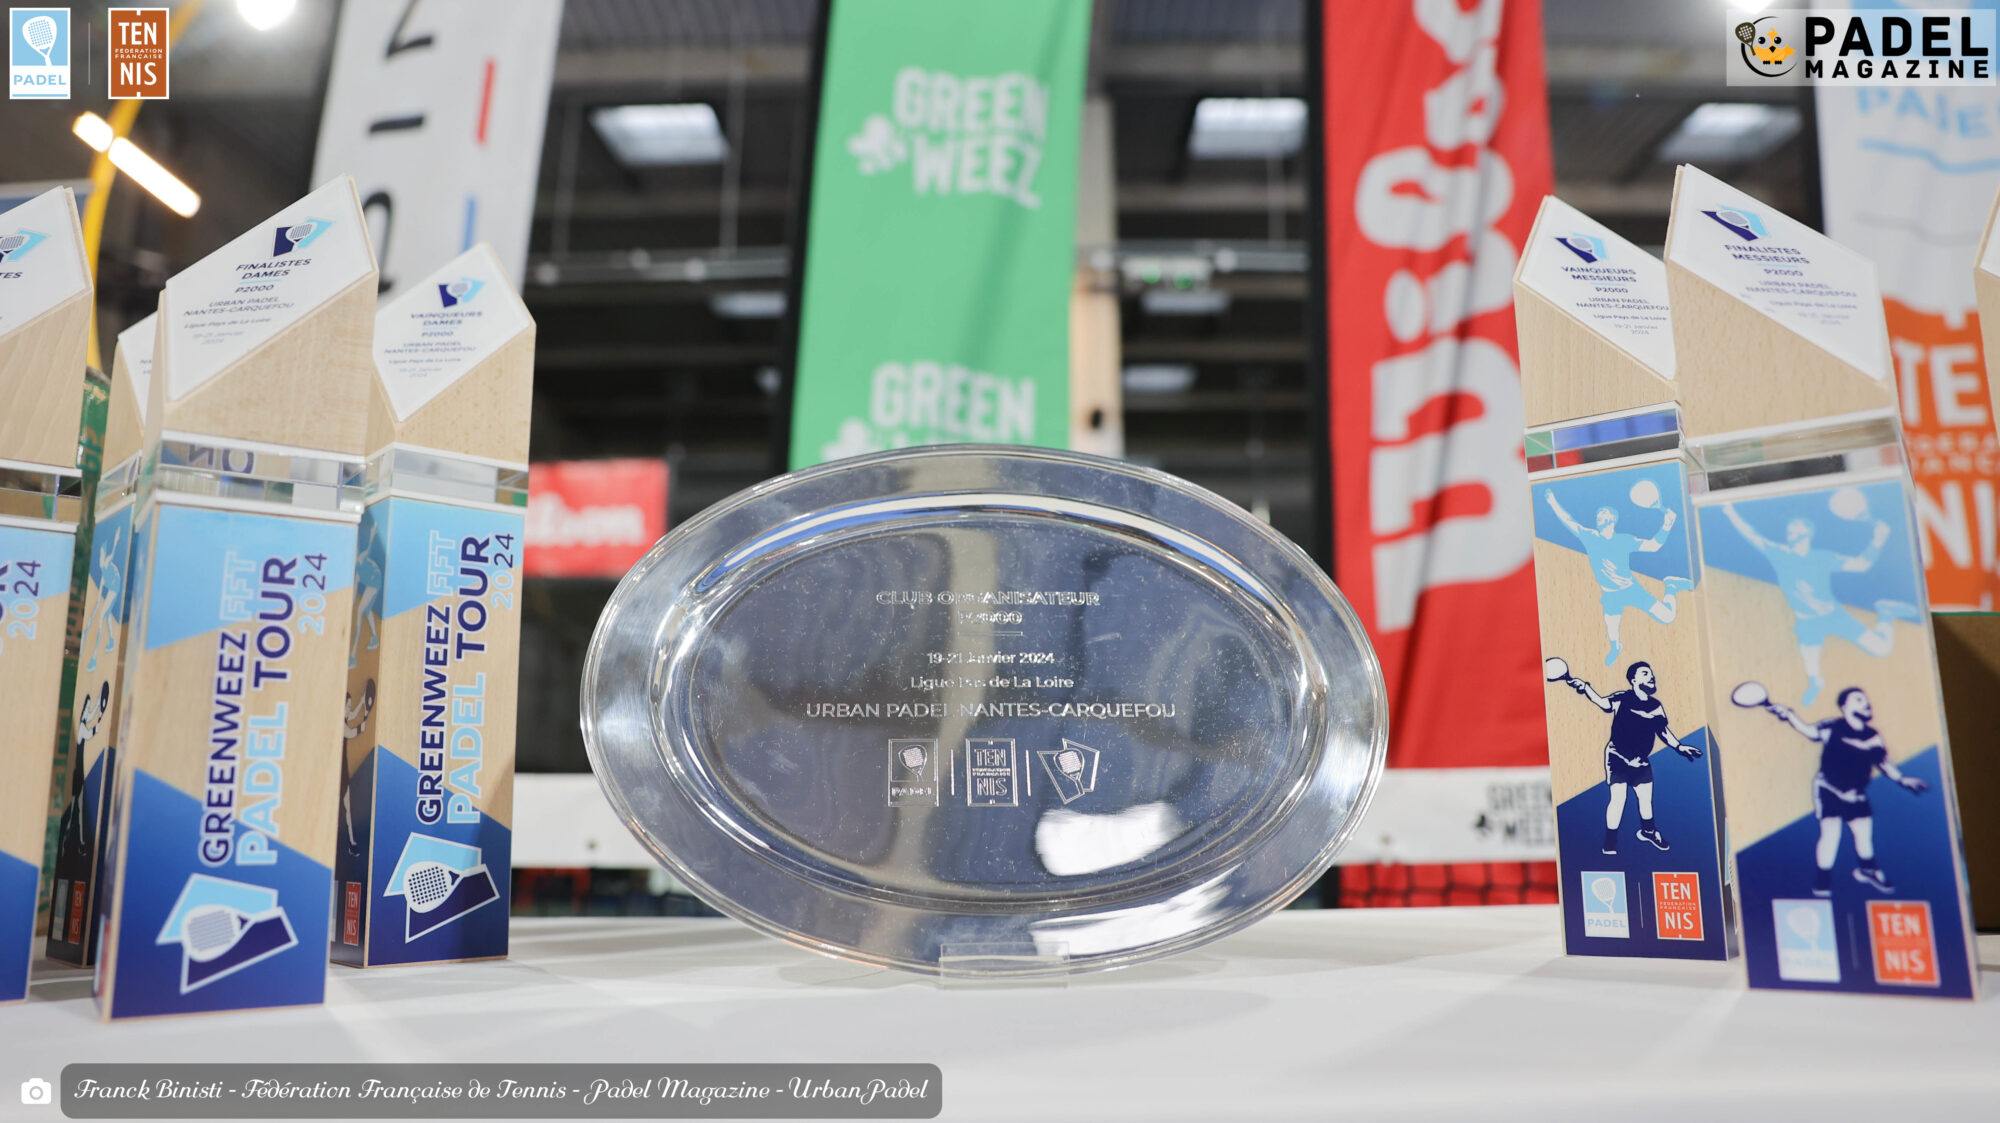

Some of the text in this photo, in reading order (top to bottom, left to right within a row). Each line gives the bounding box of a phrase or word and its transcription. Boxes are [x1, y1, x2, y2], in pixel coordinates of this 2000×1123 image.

[892, 66, 1049, 143] GREEN
[911, 130, 1043, 208] WEEZ
[1724, 244, 1801, 255] FINALISTES
[1731, 253, 1811, 264] MESSIEURS
[235, 258, 312, 271] FINALISTES
[1561, 266, 1637, 275] VAINQUEURS
[1763, 268, 1804, 277] P2000
[241, 269, 291, 280] DAMES
[1571, 274, 1637, 282] MESSIEURS
[235, 284, 275, 293] P2000
[411, 311, 483, 319] VAINQUEURS
[1891, 334, 1987, 428] TE
[872, 360, 1036, 443] GREEN
[1914, 477, 2000, 574] NI
[490, 532, 516, 611] 2024
[7, 559, 42, 641] 2024
[298, 552, 329, 637] 2024
[875, 590, 933, 606] CLUB
[1019, 652, 1055, 664] 2024
[416, 529, 457, 825] GREENWEEZ FFT
[446, 535, 492, 825] PADEL TOUR
[910, 676, 954, 691] Ligue
[988, 676, 1010, 688] de
[1013, 676, 1032, 688] La
[1036, 676, 1075, 688] Loire
[200, 550, 258, 867] GREENWEEZ FFT
[235, 555, 300, 867] PADEL TOUR
[806, 702, 1177, 719] URBAN PADEL NANTES-CARQUEFOU
[974, 748, 1007, 767] TEN
[976, 777, 1008, 796] NIS
[1485, 780, 1553, 811] GREE
[1660, 882, 1691, 900] TEN
[1587, 918, 1626, 928] PADEL
[1664, 911, 1694, 930] NIS
[1877, 912, 1922, 936] TEN
[1884, 949, 1926, 974] NIS
